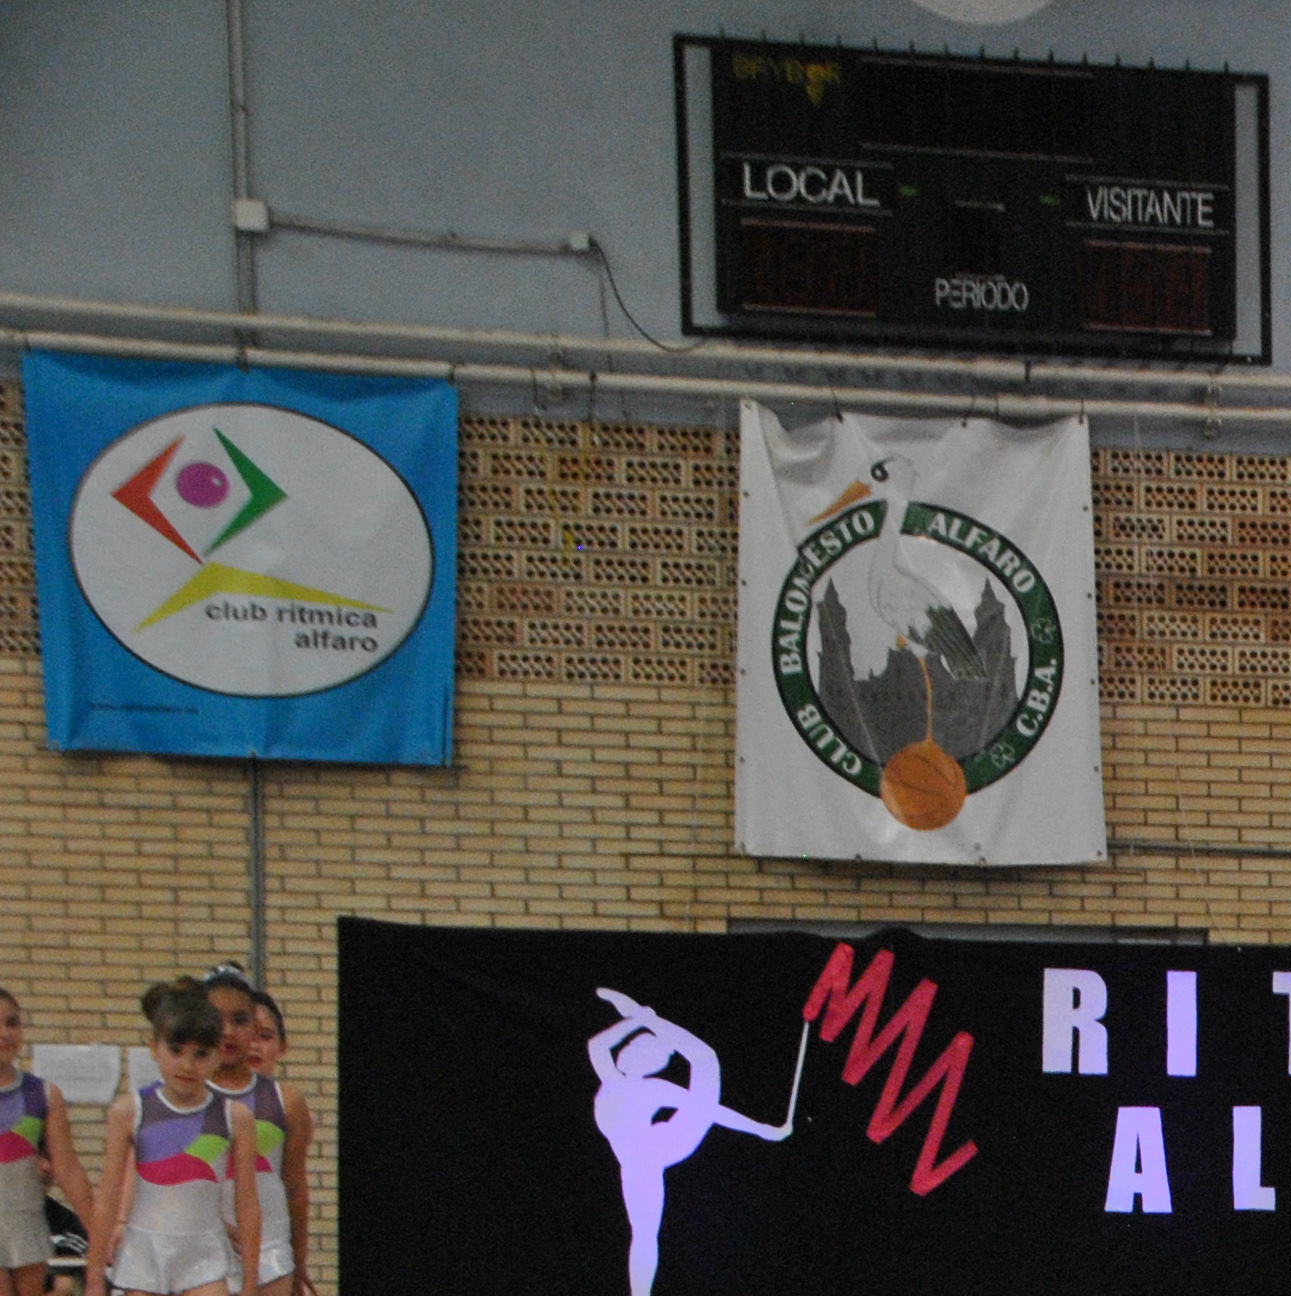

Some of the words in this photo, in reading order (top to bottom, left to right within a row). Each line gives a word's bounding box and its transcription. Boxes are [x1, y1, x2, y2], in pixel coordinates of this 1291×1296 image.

[742, 162, 880, 207] LOCAL
[1087, 185, 1215, 228] VISITANTE
[935, 275, 1029, 312] PERIODO
[929, 512, 1037, 595] ALFARO
[206, 602, 268, 623] club
[276, 604, 378, 629] ritmica
[294, 628, 379, 653] alfaro
[1015, 657, 1059, 738] C.B.A.
[795, 702, 863, 776] CLUB
